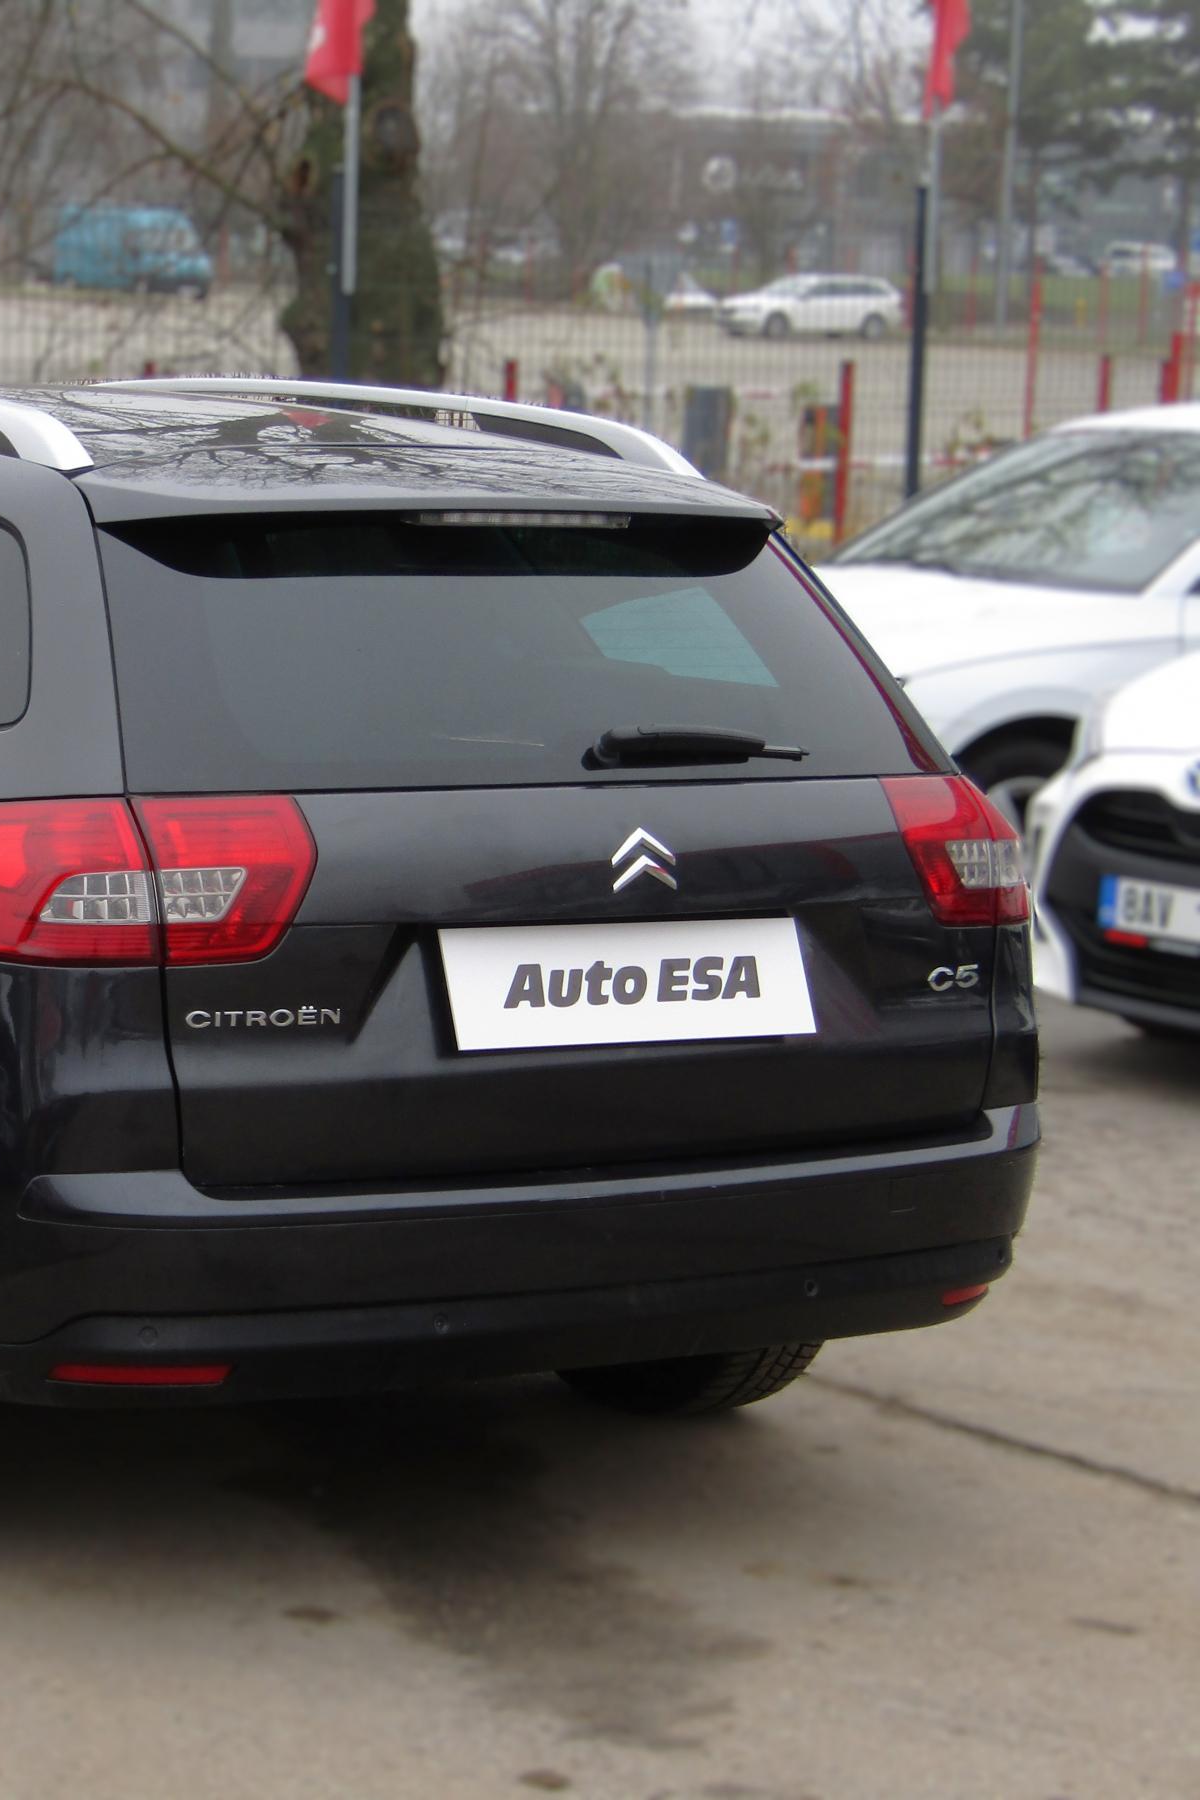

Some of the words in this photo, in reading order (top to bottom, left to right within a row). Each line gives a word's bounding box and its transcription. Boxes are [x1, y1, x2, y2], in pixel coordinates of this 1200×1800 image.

[503, 960, 648, 1009] Auto
[657, 955, 761, 1003] ESA
[927, 964, 979, 992] C5
[185, 1005, 341, 1029] CITROËN
